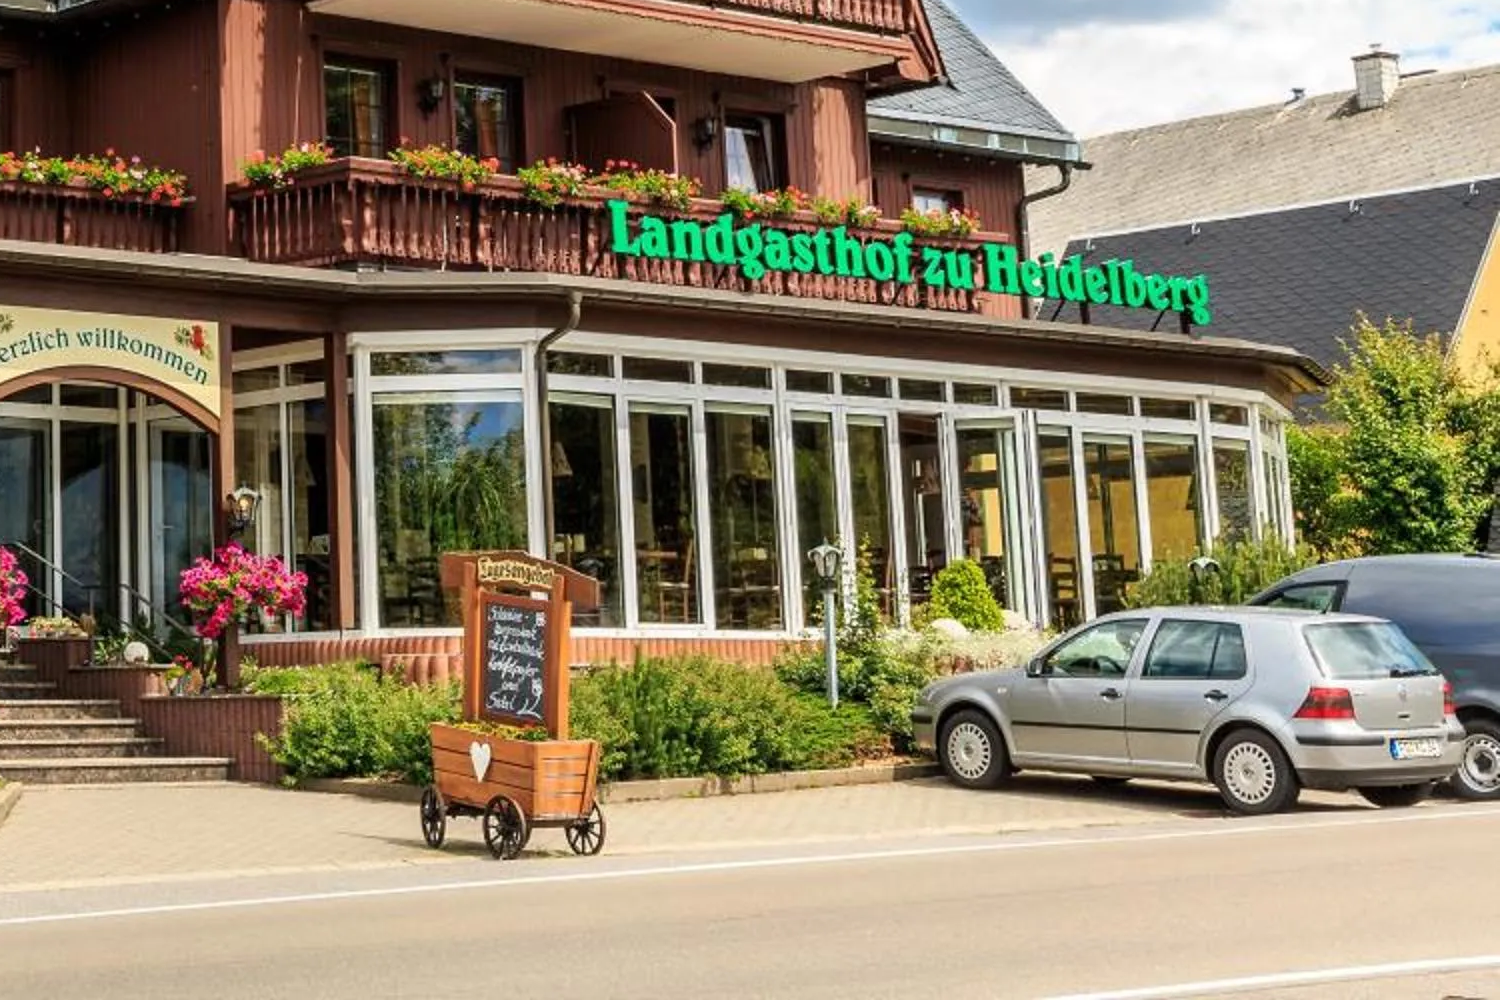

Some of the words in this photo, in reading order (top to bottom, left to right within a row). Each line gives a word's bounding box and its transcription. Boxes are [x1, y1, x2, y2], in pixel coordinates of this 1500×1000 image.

[606, 199, 914, 284] Landgasthof
[923, 246, 975, 292] zu
[983, 241, 1212, 325] Heidelberg
[76, 328, 209, 386] willkommen
